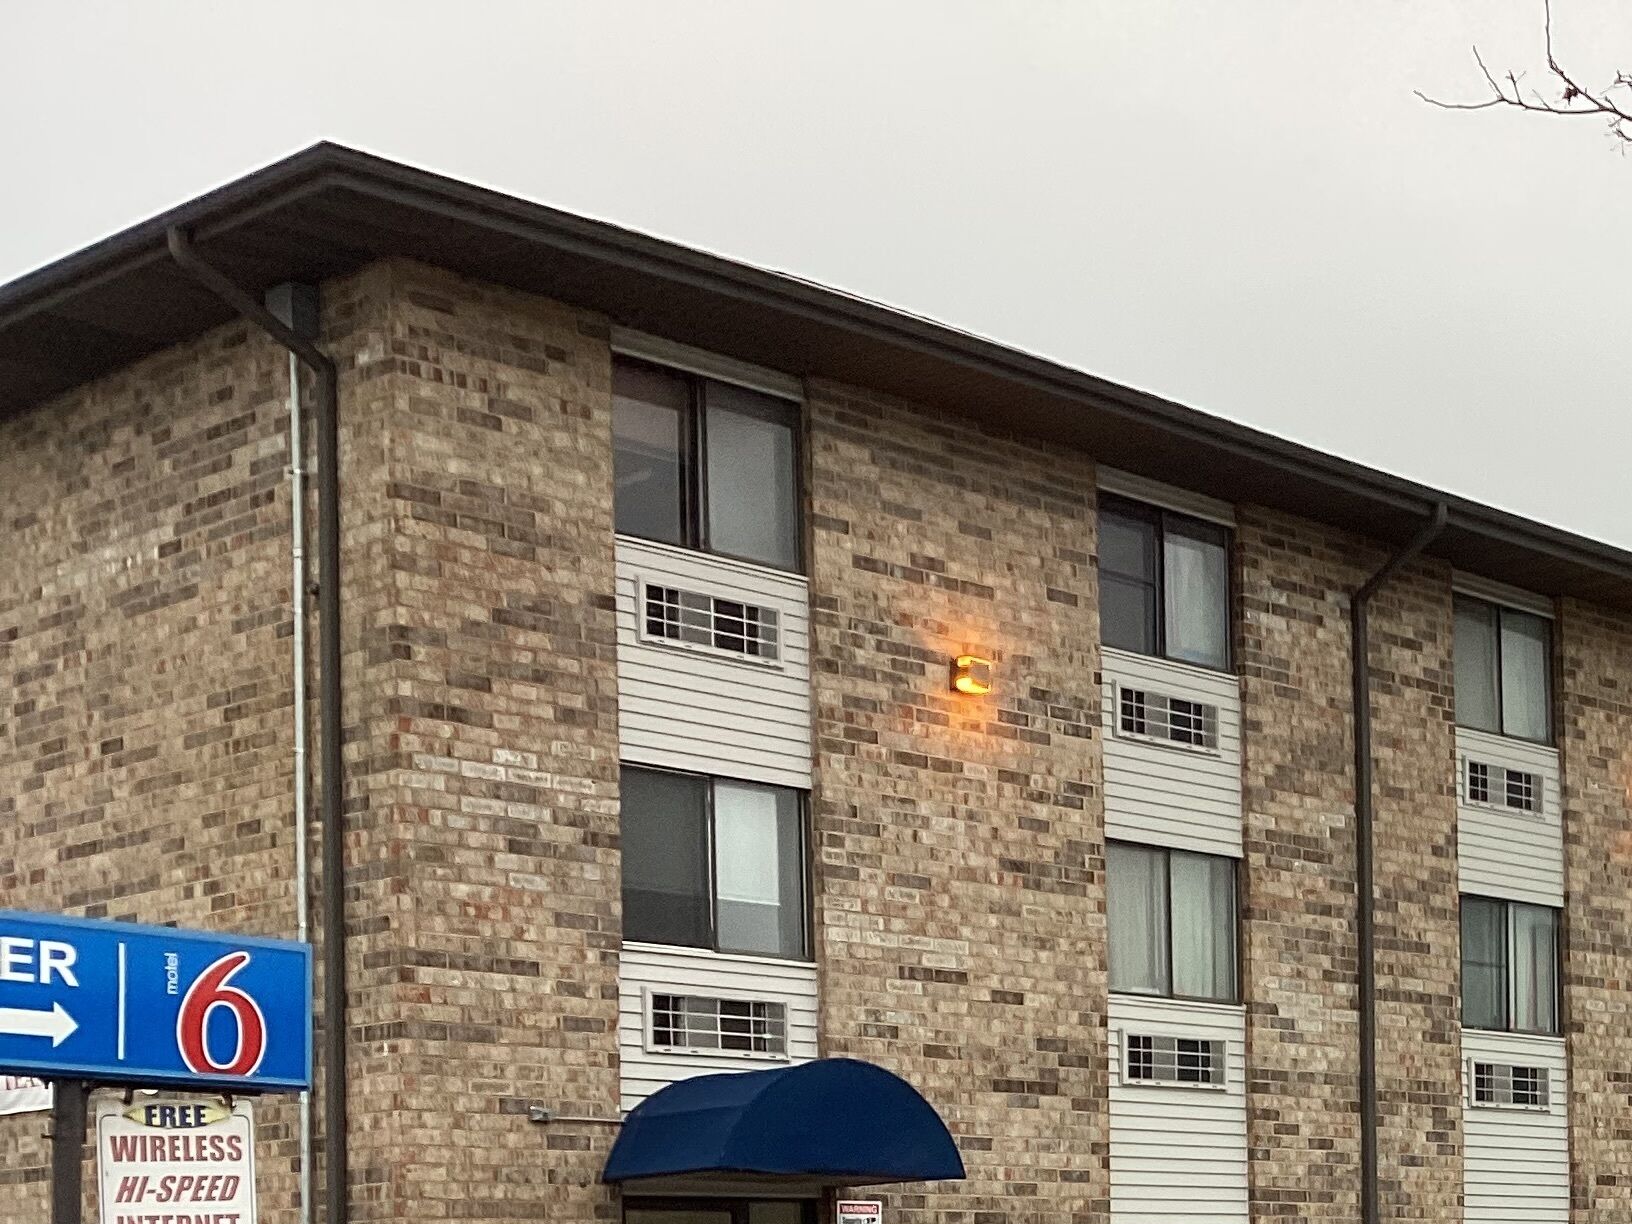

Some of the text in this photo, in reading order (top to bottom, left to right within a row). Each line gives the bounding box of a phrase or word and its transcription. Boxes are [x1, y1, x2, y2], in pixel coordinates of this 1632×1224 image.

[0, 936, 80, 988] ER
[164, 952, 179, 995] motel
[176, 950, 267, 1077] 6
[144, 1104, 208, 1128] FREE
[110, 1135, 243, 1162] WIRELESS
[115, 1175, 241, 1203] HI-SPEED
